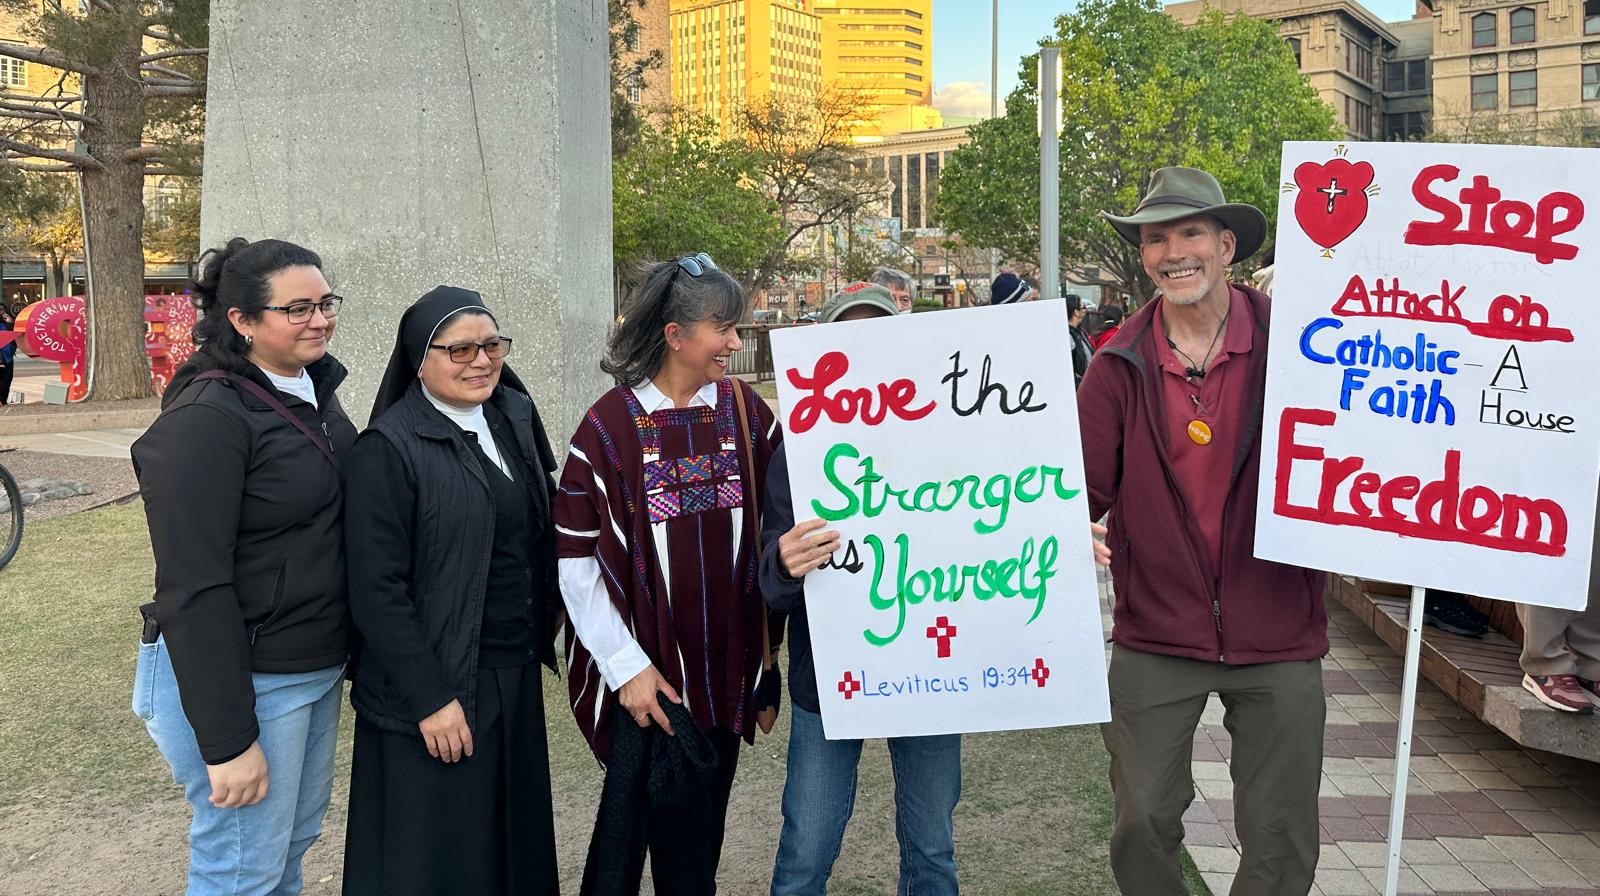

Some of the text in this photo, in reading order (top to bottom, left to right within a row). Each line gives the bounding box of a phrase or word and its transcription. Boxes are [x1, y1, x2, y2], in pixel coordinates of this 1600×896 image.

[1411, 164, 1585, 264] Stop
[58, 303, 76, 312] WE
[1331, 275, 1550, 330] Attack on
[786, 350, 1048, 434] Love the
[1299, 317, 1460, 375] Catholic
[1489, 344, 1529, 390] A
[1339, 368, 1576, 433] Faith House
[810, 442, 1081, 535] Stranger
[1273, 407, 1568, 557] Freedom
[863, 532, 1059, 647] Yourself
[861, 666, 1032, 697] Leviticus 19:34
